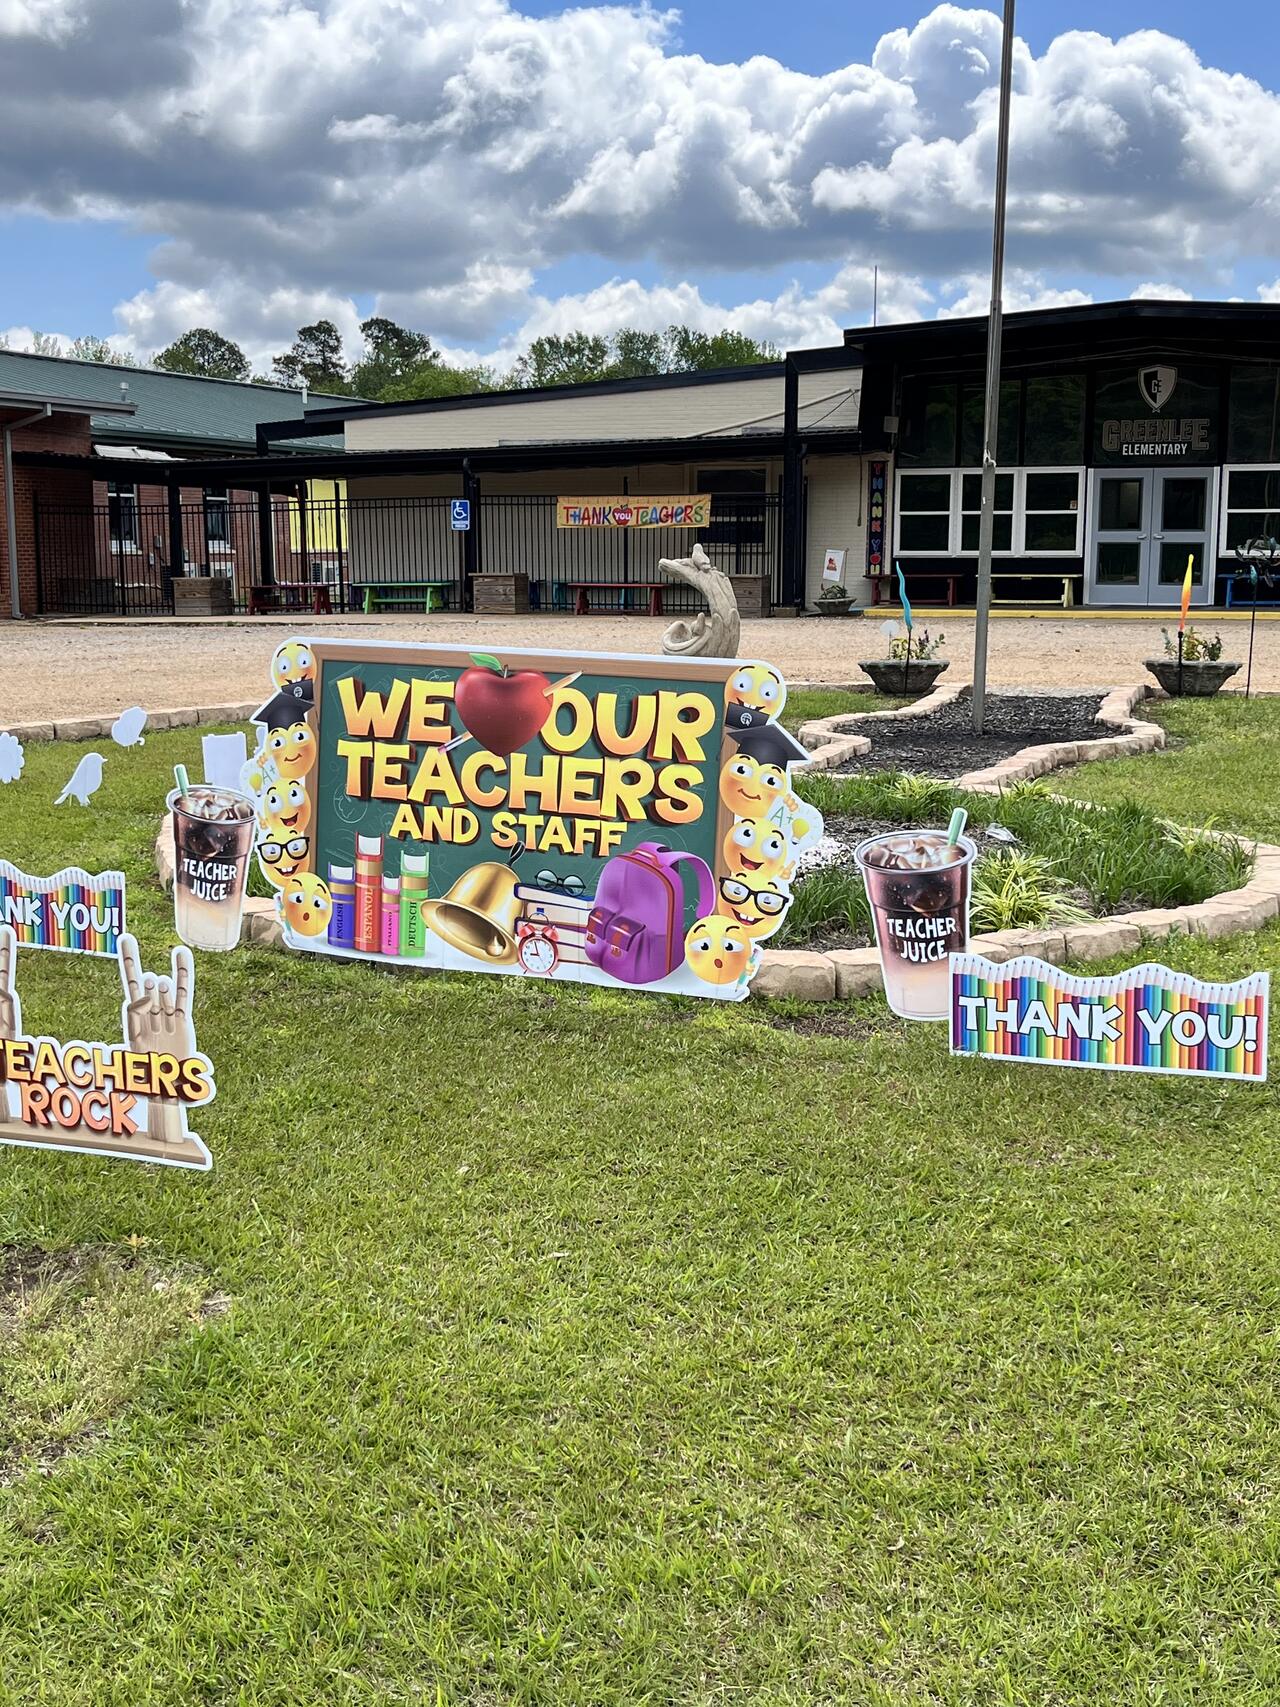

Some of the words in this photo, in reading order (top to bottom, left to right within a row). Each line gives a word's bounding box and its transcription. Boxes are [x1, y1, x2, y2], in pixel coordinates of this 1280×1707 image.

[1102, 418, 1209, 451] GREENLEE
[1122, 443, 1187, 455] ELEMENTARY
[563, 505, 612, 525] THANK
[614, 512, 631, 520] YOU
[336, 676, 456, 744] WE
[540, 687, 716, 763] OUR
[336, 739, 705, 825] TEACHERS
[388, 803, 480, 845] AND
[490, 811, 628, 858] STAFF
[769, 806, 795, 829] A+
[182, 857, 237, 881] TEACHER
[190, 878, 228, 901] JUICE
[49, 901, 120, 936] YOU!
[408, 901, 417, 947] DEUTSCH
[886, 917, 957, 939] TEACHER
[900, 940, 948, 963] JUICE
[958, 996, 1123, 1043] THANK
[1136, 1008, 1259, 1053] YOU!
[0, 1039, 211, 1101] EACHERS
[20, 1081, 140, 1136] ROCK
